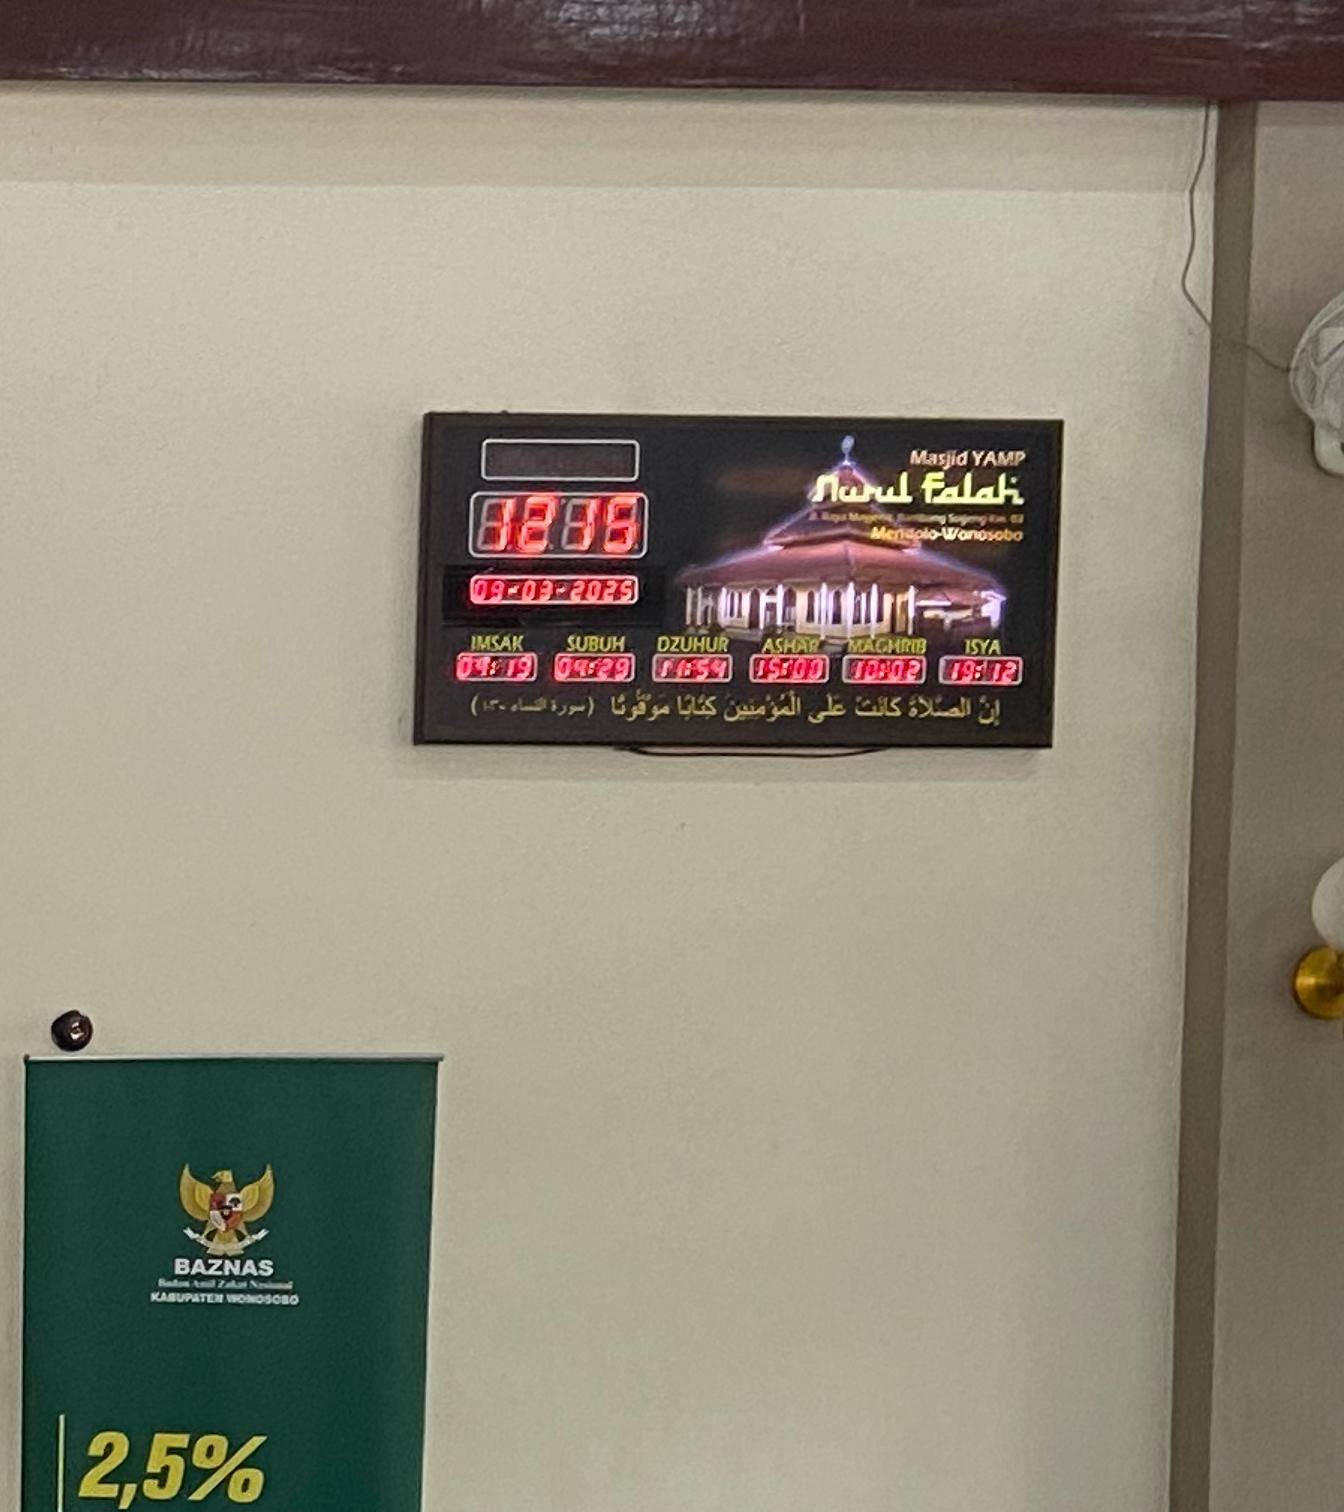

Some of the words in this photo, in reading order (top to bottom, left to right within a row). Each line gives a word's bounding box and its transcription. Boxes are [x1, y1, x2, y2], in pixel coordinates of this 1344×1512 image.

[910, 450, 968, 469] Masjid
[972, 451, 1027, 467] YAMP
[809, 472, 913, 503] Nurul
[921, 471, 1025, 505] Falah
[475, 580, 633, 602] 09-03-2025
[470, 635, 525, 651] IMSAK
[566, 635, 627, 652] SUBUH
[657, 636, 730, 652] DZUHUR
[761, 638, 821, 654] ASHAR
[848, 638, 928, 654] MAGHRIB
[964, 639, 1003, 654] ISYA
[174, 1257, 275, 1277] BAZNAS
[150, 1291, 224, 1304] KABUPATEN
[226, 1293, 300, 1305] WONOSOBO
[78, 1431, 268, 1510] 2,5%
